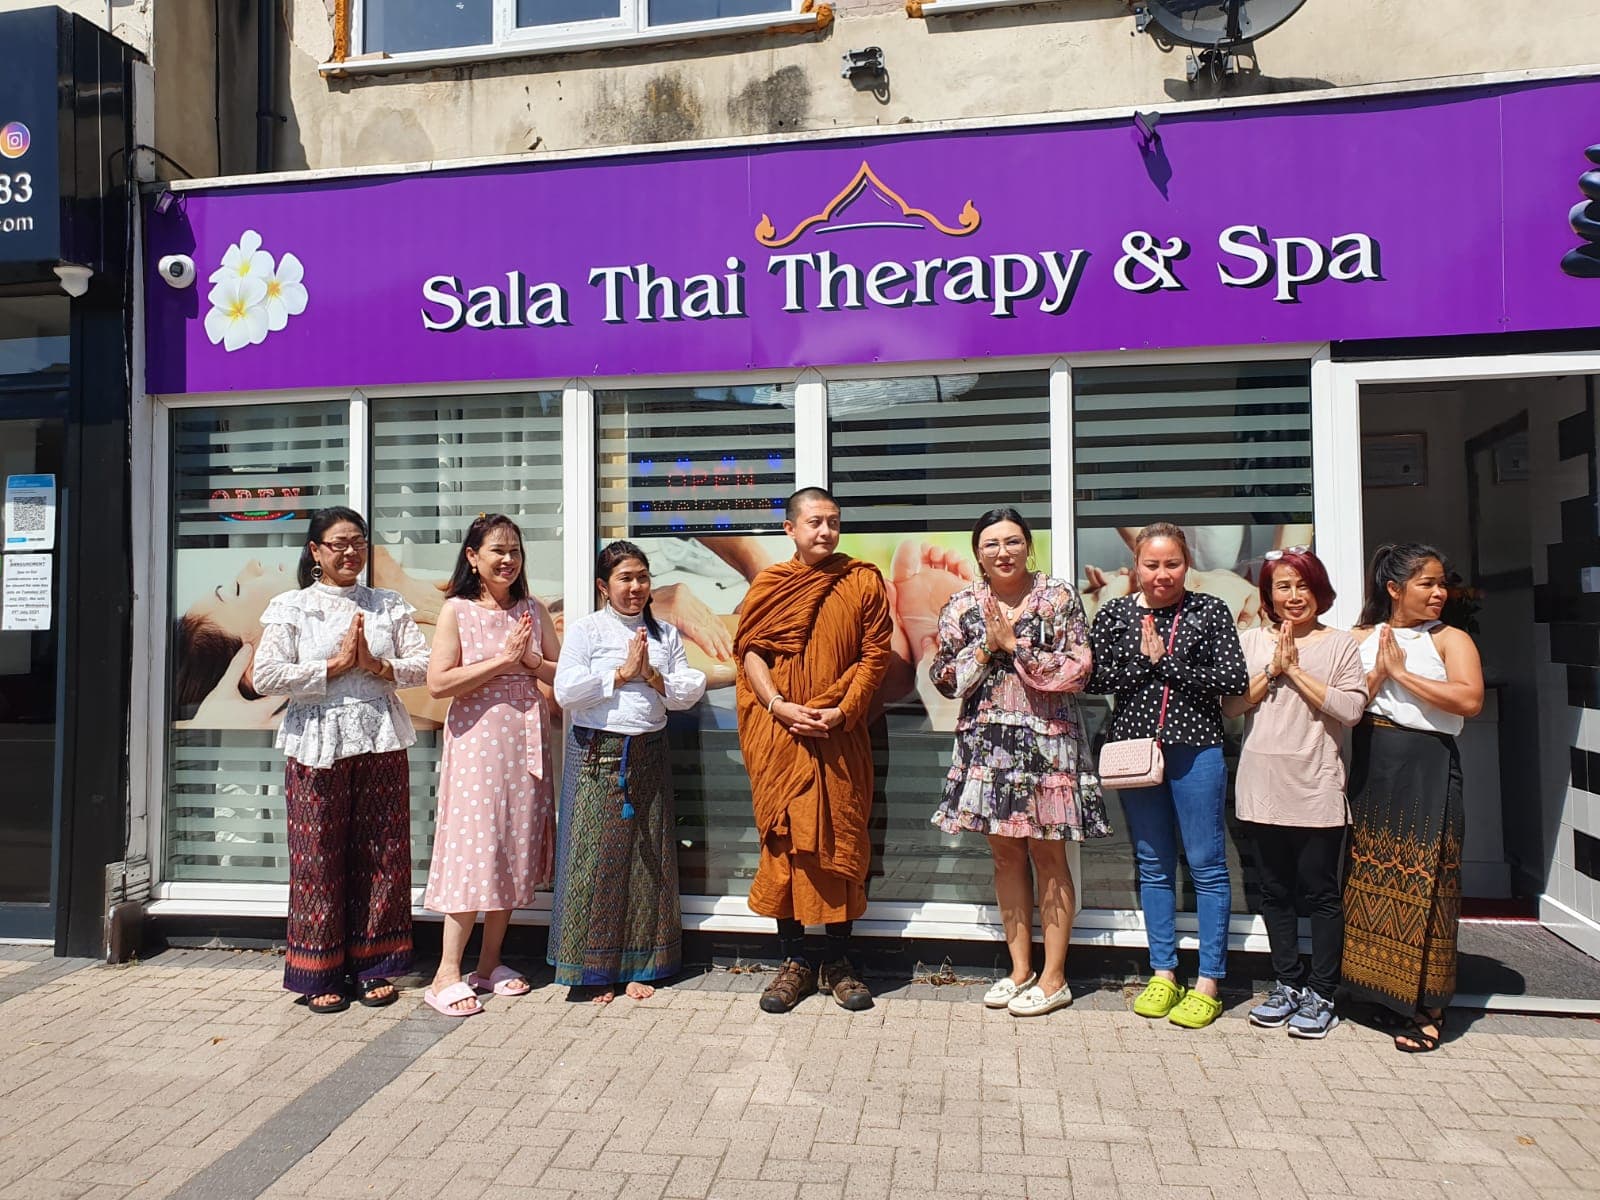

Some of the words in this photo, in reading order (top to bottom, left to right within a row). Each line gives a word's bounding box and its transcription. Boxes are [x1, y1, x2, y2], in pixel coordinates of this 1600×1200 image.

[0, 216, 34, 232] om
[421, 270, 569, 331] Sala
[587, 256, 746, 322] Thai
[767, 249, 1086, 317] Therapy
[1113, 230, 1184, 291] &
[1217, 225, 1380, 302] Spa
